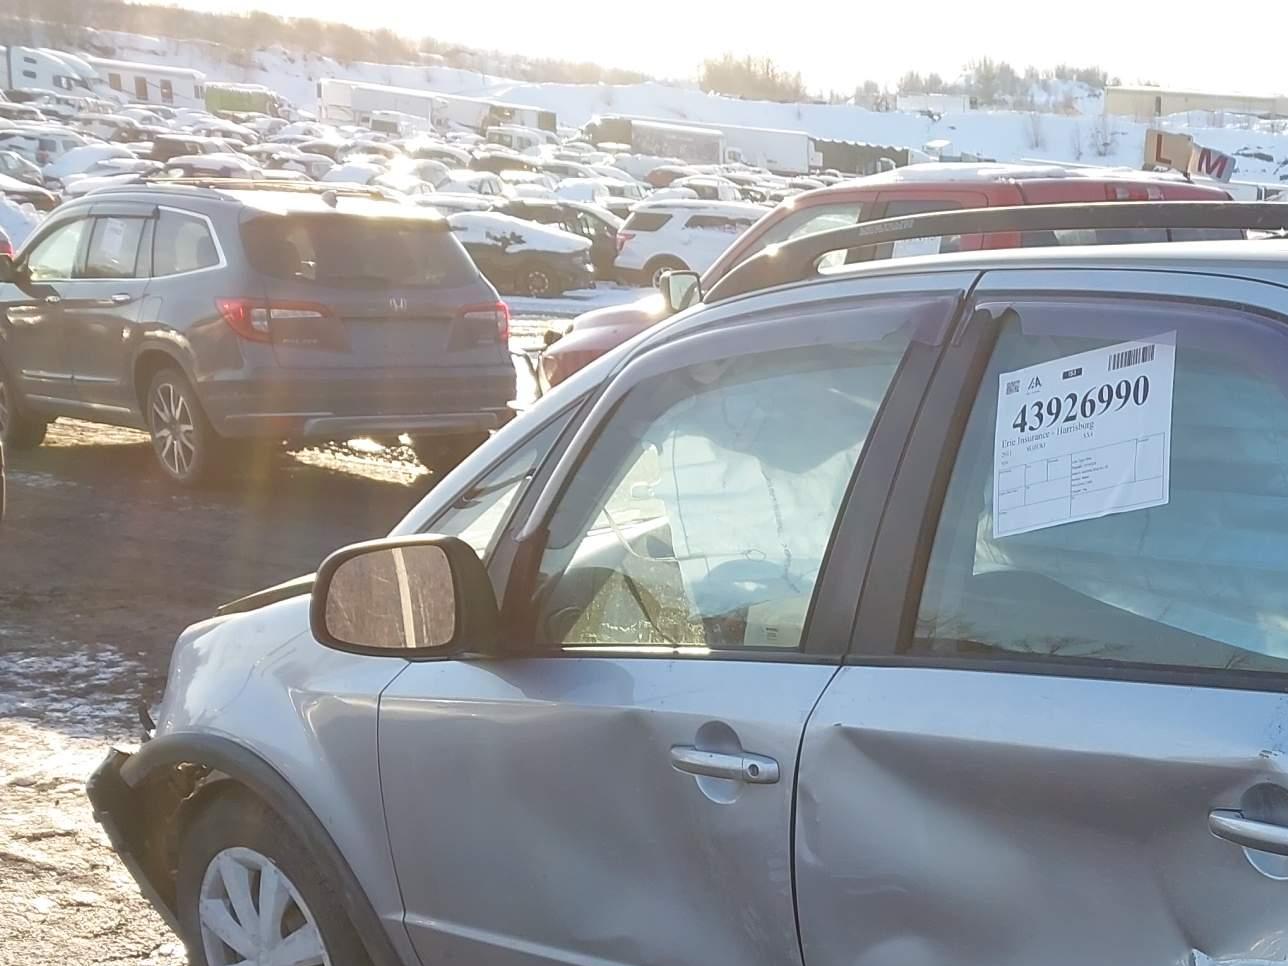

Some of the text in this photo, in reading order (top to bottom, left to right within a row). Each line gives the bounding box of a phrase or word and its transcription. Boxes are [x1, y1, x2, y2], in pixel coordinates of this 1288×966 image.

[1156, 134, 1172, 165] L
[1198, 147, 1228, 178] M
[1012, 375, 1150, 433] 43926990
